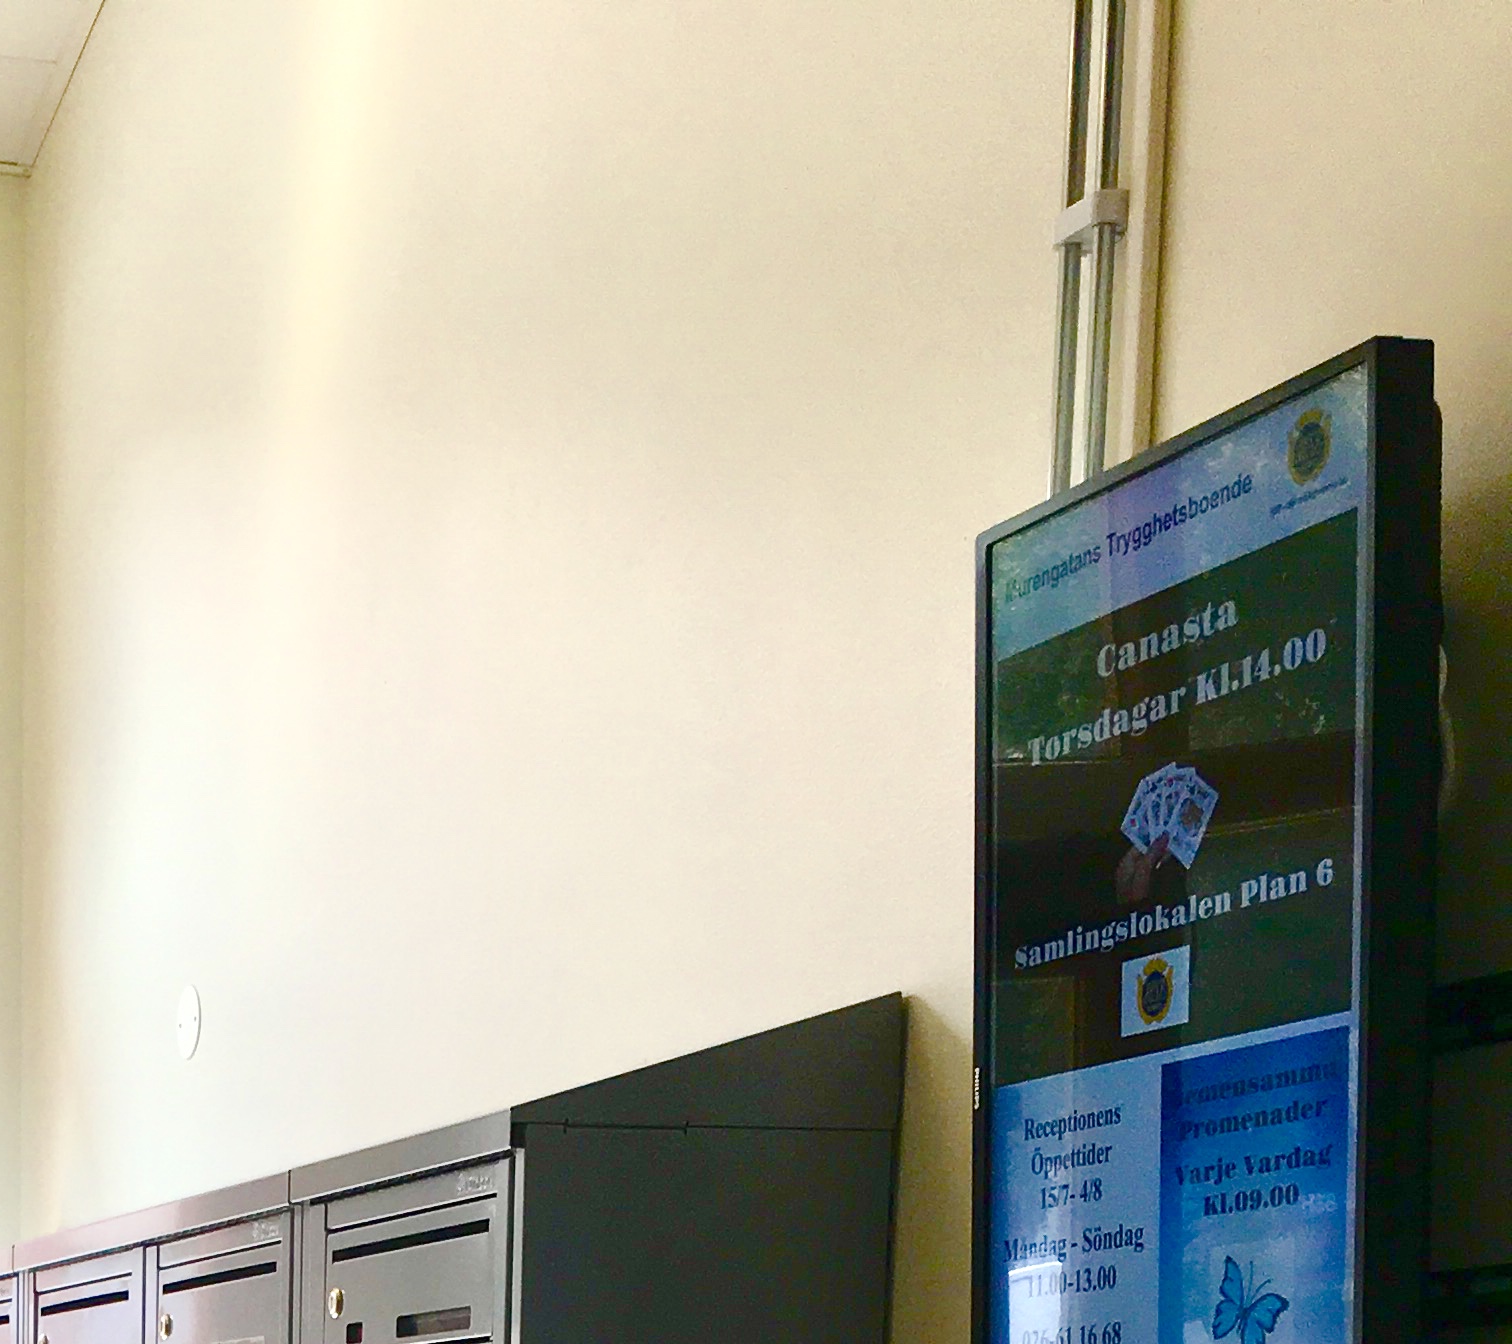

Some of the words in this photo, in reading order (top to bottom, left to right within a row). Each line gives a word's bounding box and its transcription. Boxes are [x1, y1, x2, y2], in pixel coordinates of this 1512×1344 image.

[1106, 473, 1253, 557] Trygghetsboende
[1097, 600, 1238, 677] Canasta
[1027, 686, 1186, 766] Torsdagar
[1195, 628, 1327, 705] Kl.14.00
[1015, 892, 1232, 969] Samlingslokalen
[1241, 869, 1307, 908] Plan
[1316, 858, 1333, 887] 6
[1024, 1106, 1122, 1141] Receptionens
[1178, 1099, 1328, 1142] Promenader
[1031, 1142, 1113, 1180] Öppettider
[1176, 1156, 1236, 1187] Varje
[1243, 1143, 1333, 1177] Vardag
[1080, 1177, 1103, 1203] 4/8
[1203, 1182, 1300, 1217] Kl.09.00
[1082, 1224, 1144, 1253] Söndag
[1027, 1264, 1117, 1298] 11.00-13.00
